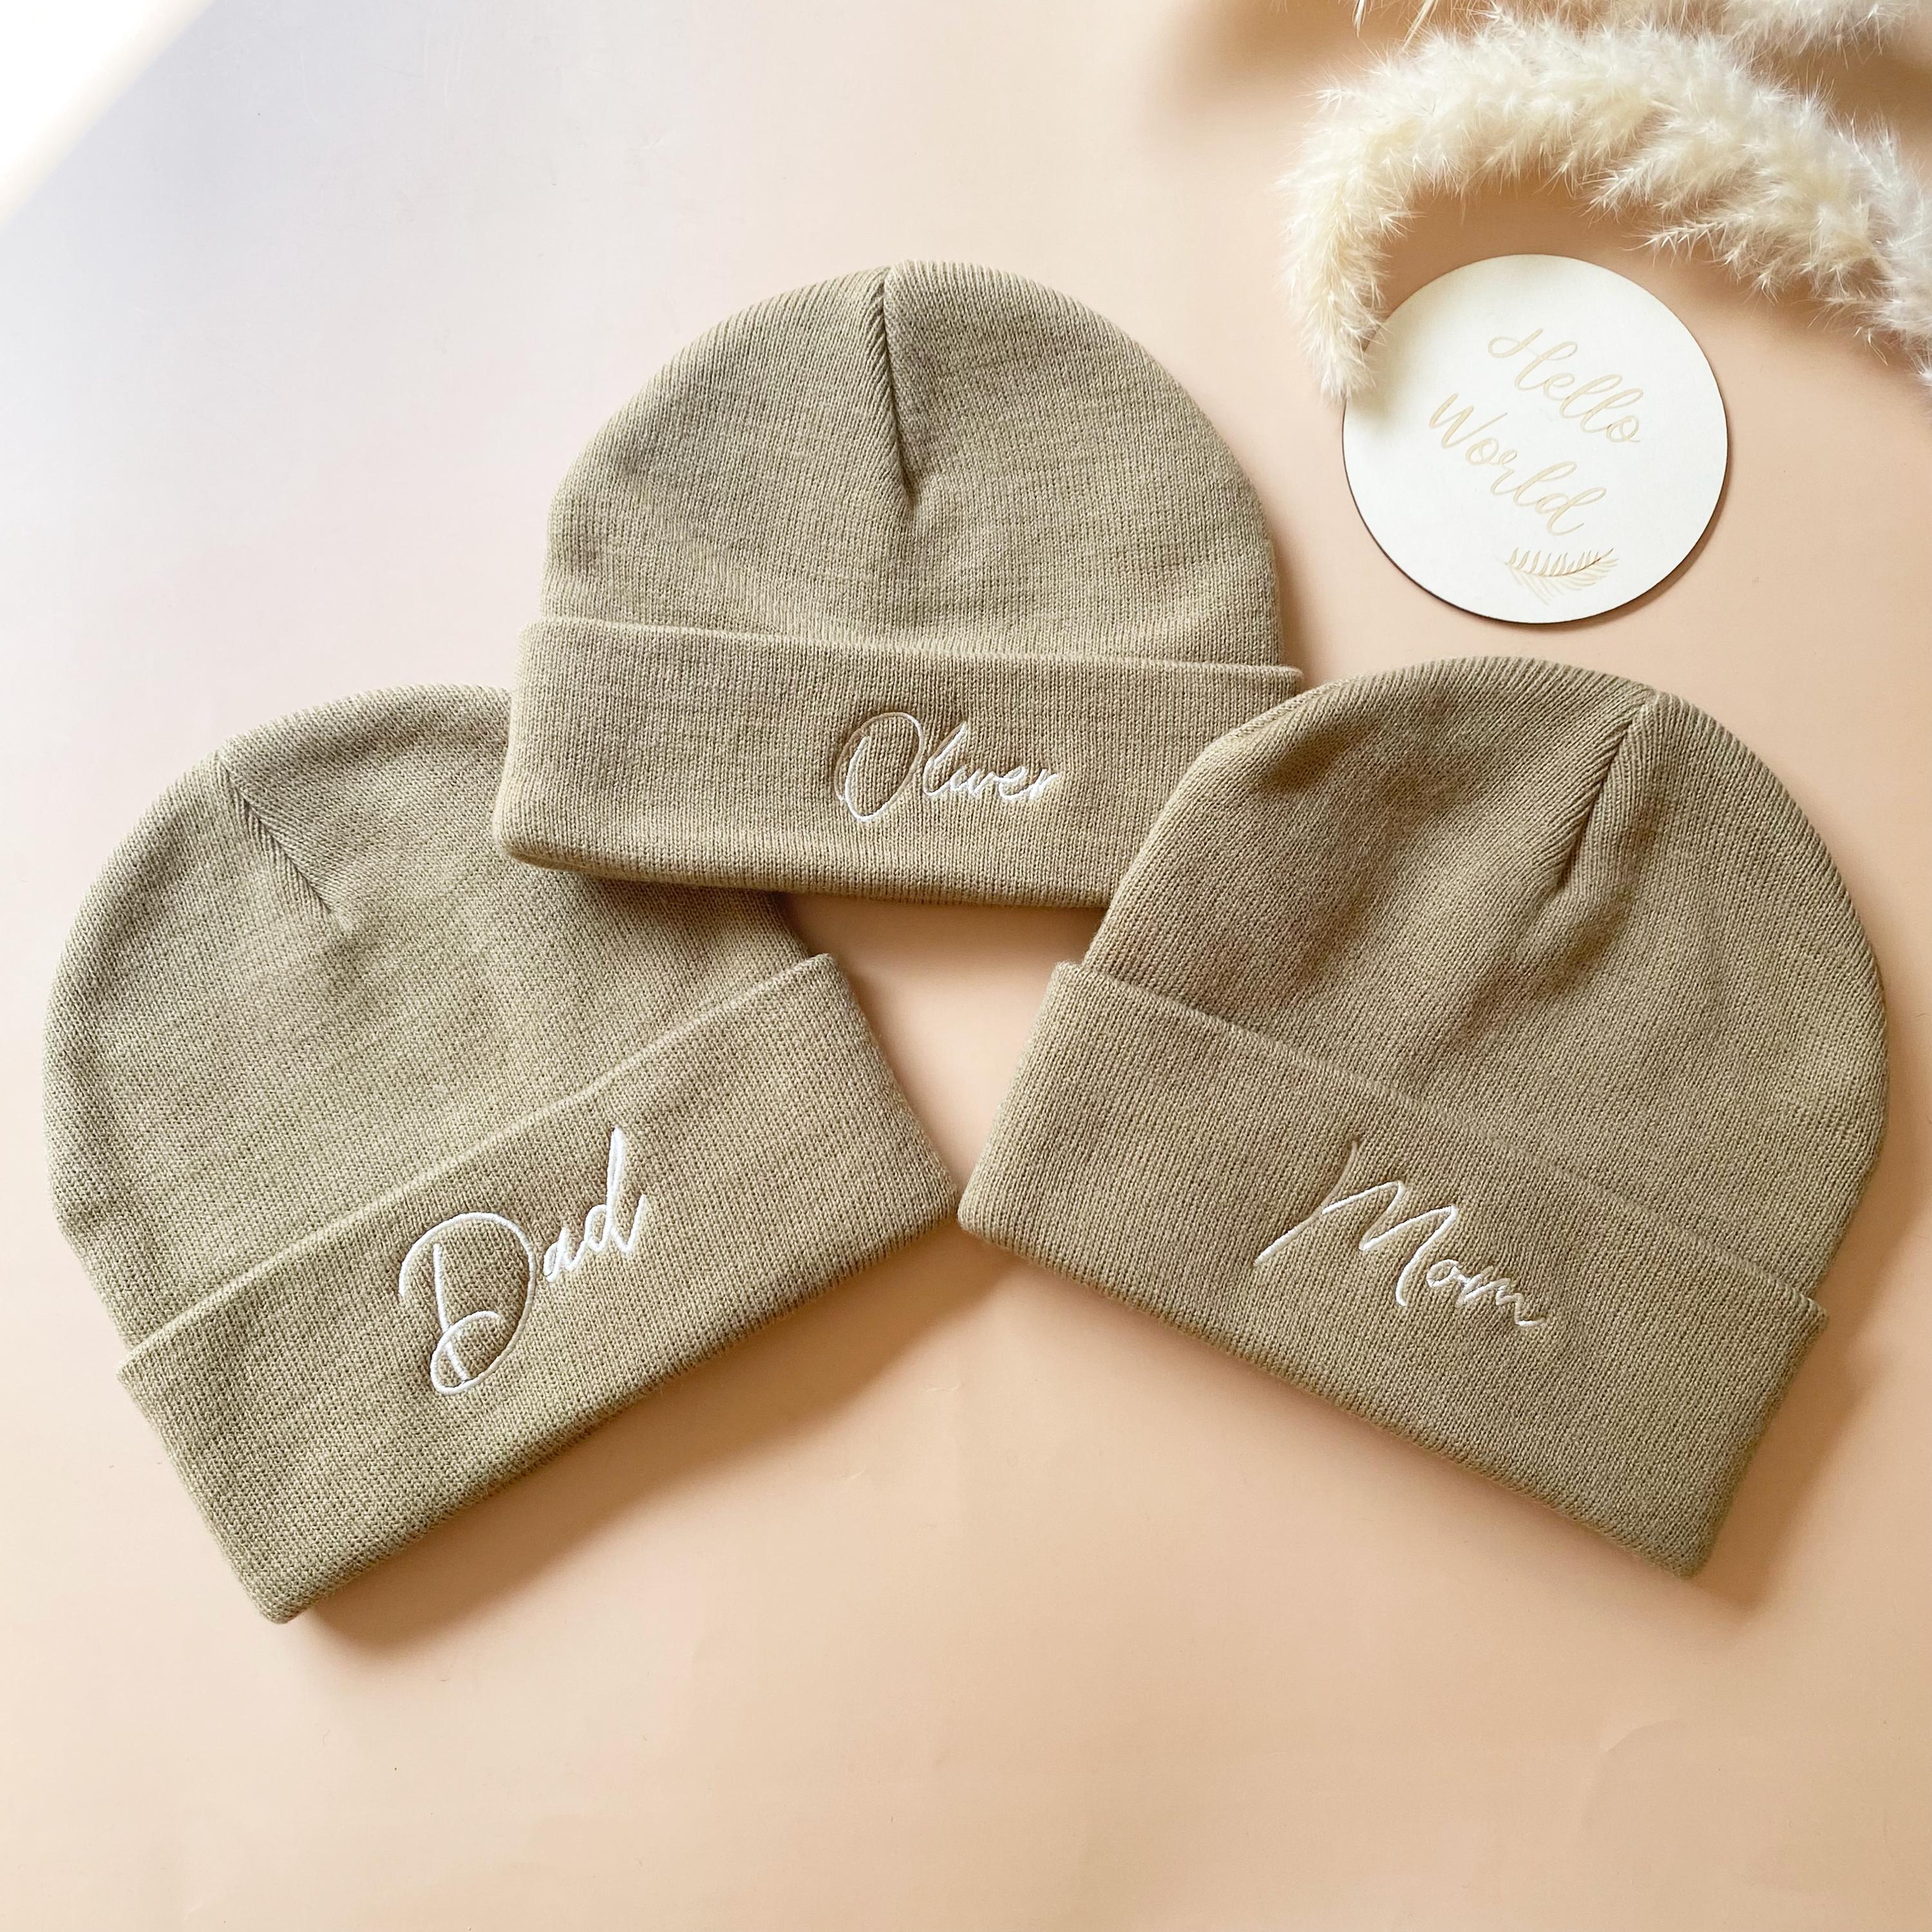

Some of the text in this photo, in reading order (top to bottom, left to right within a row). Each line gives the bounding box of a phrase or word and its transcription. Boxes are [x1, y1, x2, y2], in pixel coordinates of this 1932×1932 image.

[1488, 328, 1644, 443] Hello
[1428, 392, 1607, 536] World
[834, 711, 1059, 822] Oliver
[398, 1126, 647, 1396] Dad
[1253, 1140, 1547, 1327] Mom
